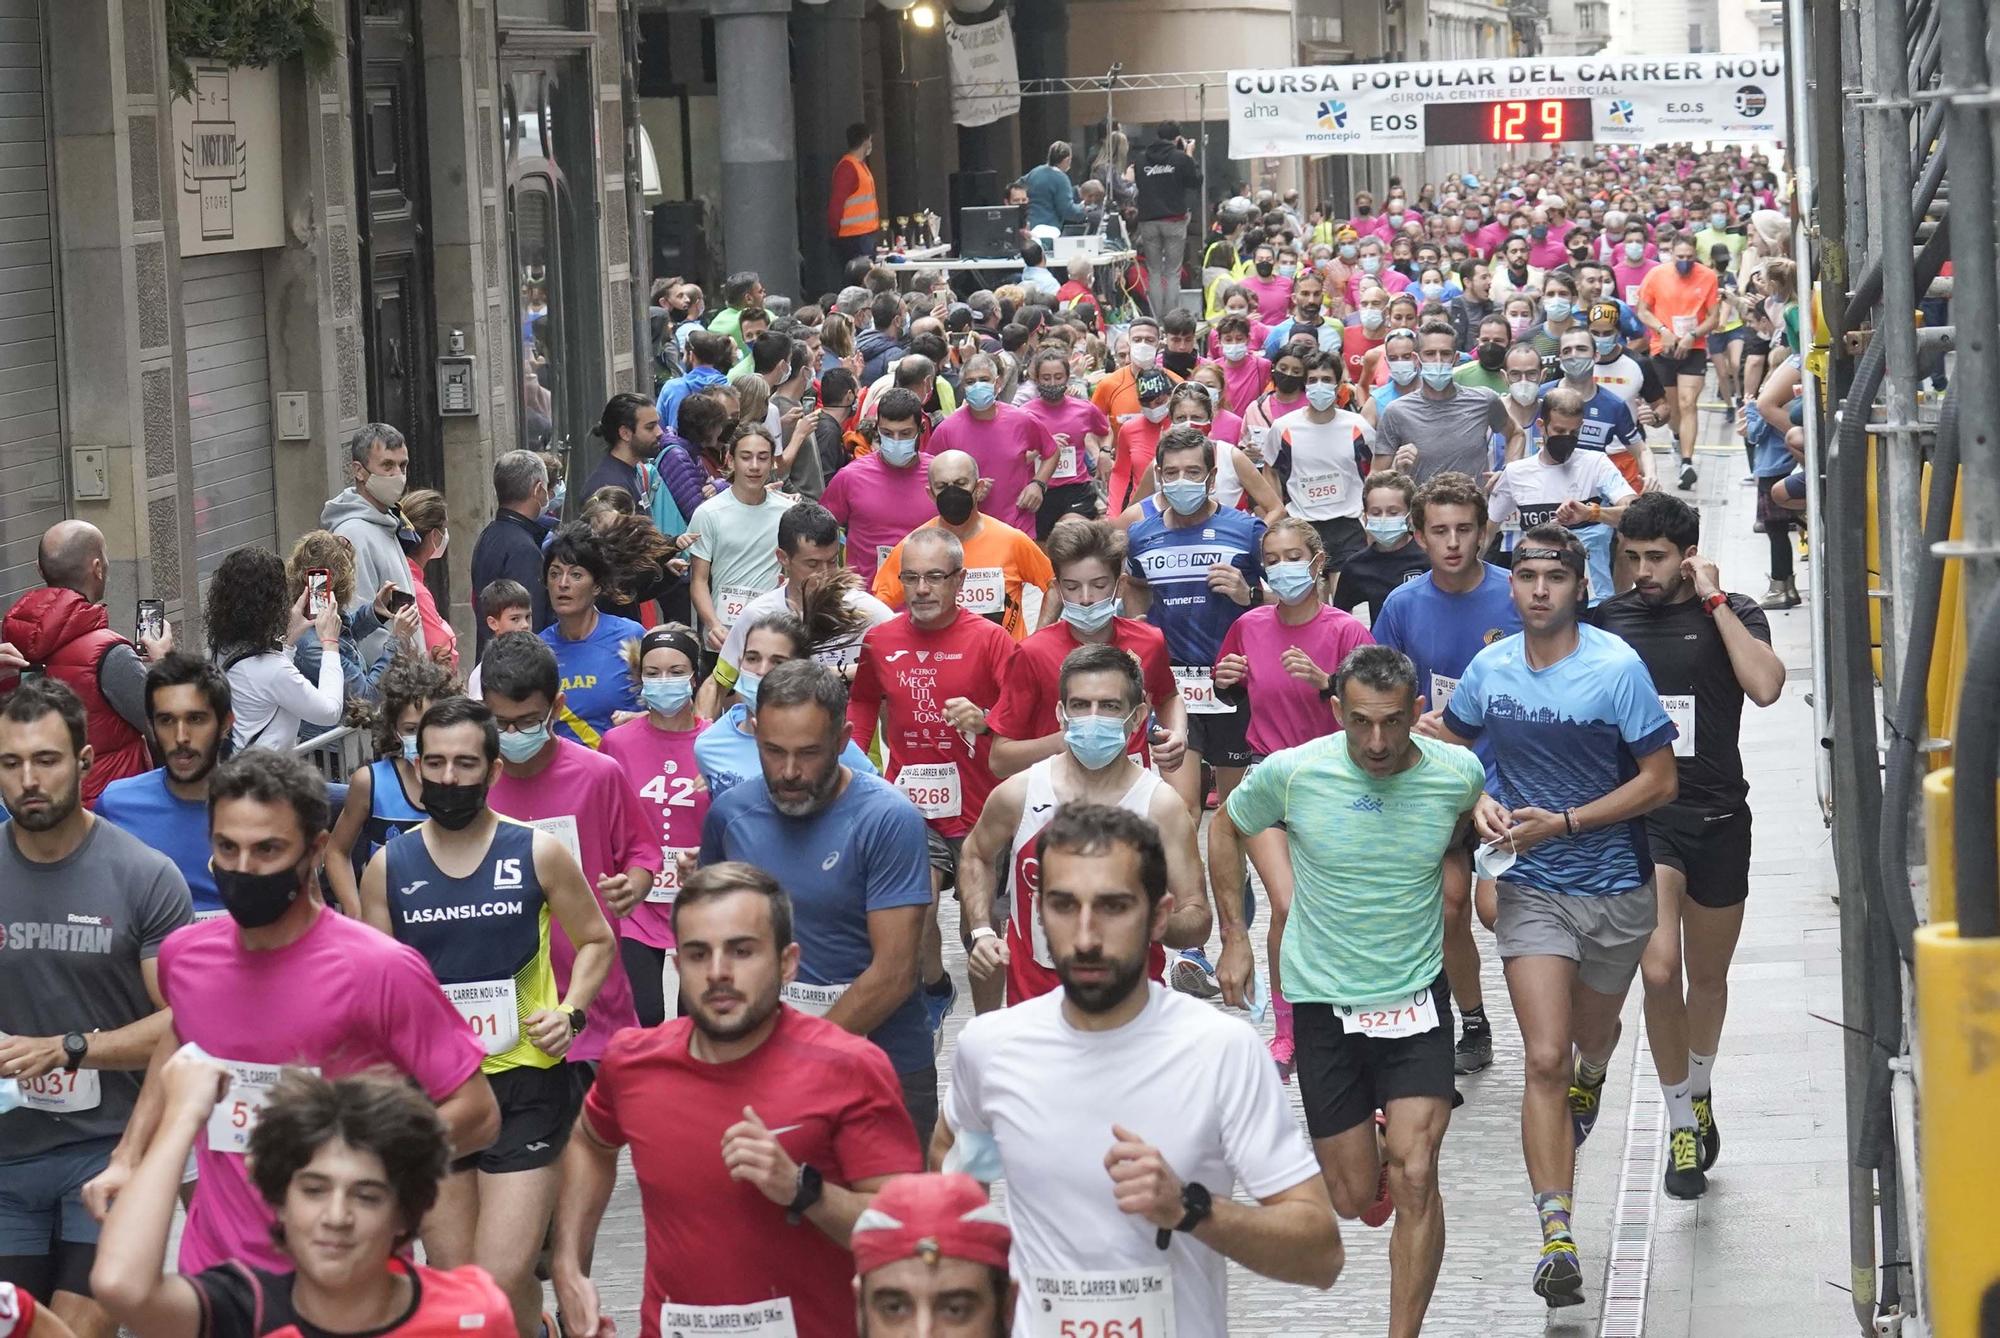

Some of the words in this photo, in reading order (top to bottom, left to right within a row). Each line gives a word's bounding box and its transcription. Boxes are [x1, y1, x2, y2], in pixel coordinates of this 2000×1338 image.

[1235, 73, 1339, 94] CURSA
[1352, 66, 1495, 91] POPULAR
[1509, 64, 1564, 83] DEL
[1577, 61, 1703, 82] CARRER
[1715, 59, 1780, 78] NOU
[1450, 88, 1504, 100] CENTRE
[1510, 87, 1533, 98] EIX
[1244, 102, 1279, 119] alma
[1370, 113, 1418, 131] EOS
[204, 196, 228, 210] STORE
[1308, 484, 1337, 498] 5256
[1147, 554, 1189, 570] TGCB
[1193, 553, 1220, 566] INN
[956, 588, 995, 603] 5305
[900, 676, 937, 689] MEGA
[918, 698, 937, 712] CA
[1665, 700, 1678, 709] NOU
[639, 775, 696, 808] 42
[908, 787, 950, 805] 5268
[493, 858, 522, 886] LS
[403, 901, 523, 924] LASANSI.COM
[9, 922, 113, 954] SPARTAN
[453, 988, 479, 1001] CARRER
[480, 987, 494, 999] NOU
[495, 986, 509, 998] 5Km
[802, 989, 826, 1002] CARRER
[1358, 1006, 1417, 1028] 5271
[1036, 1277, 1059, 1294] CURSA
[1062, 1279, 1078, 1296] DEL
[1080, 1279, 1117, 1296] CARRER
[1119, 1278, 1140, 1294] NOU
[1142, 1276, 1164, 1293] 5Km
[667, 1311, 691, 1328] CURSA
[693, 1312, 708, 1328] DEL
[709, 1313, 741, 1329] CARRER
[743, 1311, 762, 1327] NOU
[764, 1308, 785, 1323] 5Km
[1060, 1316, 1145, 1338] 5261
